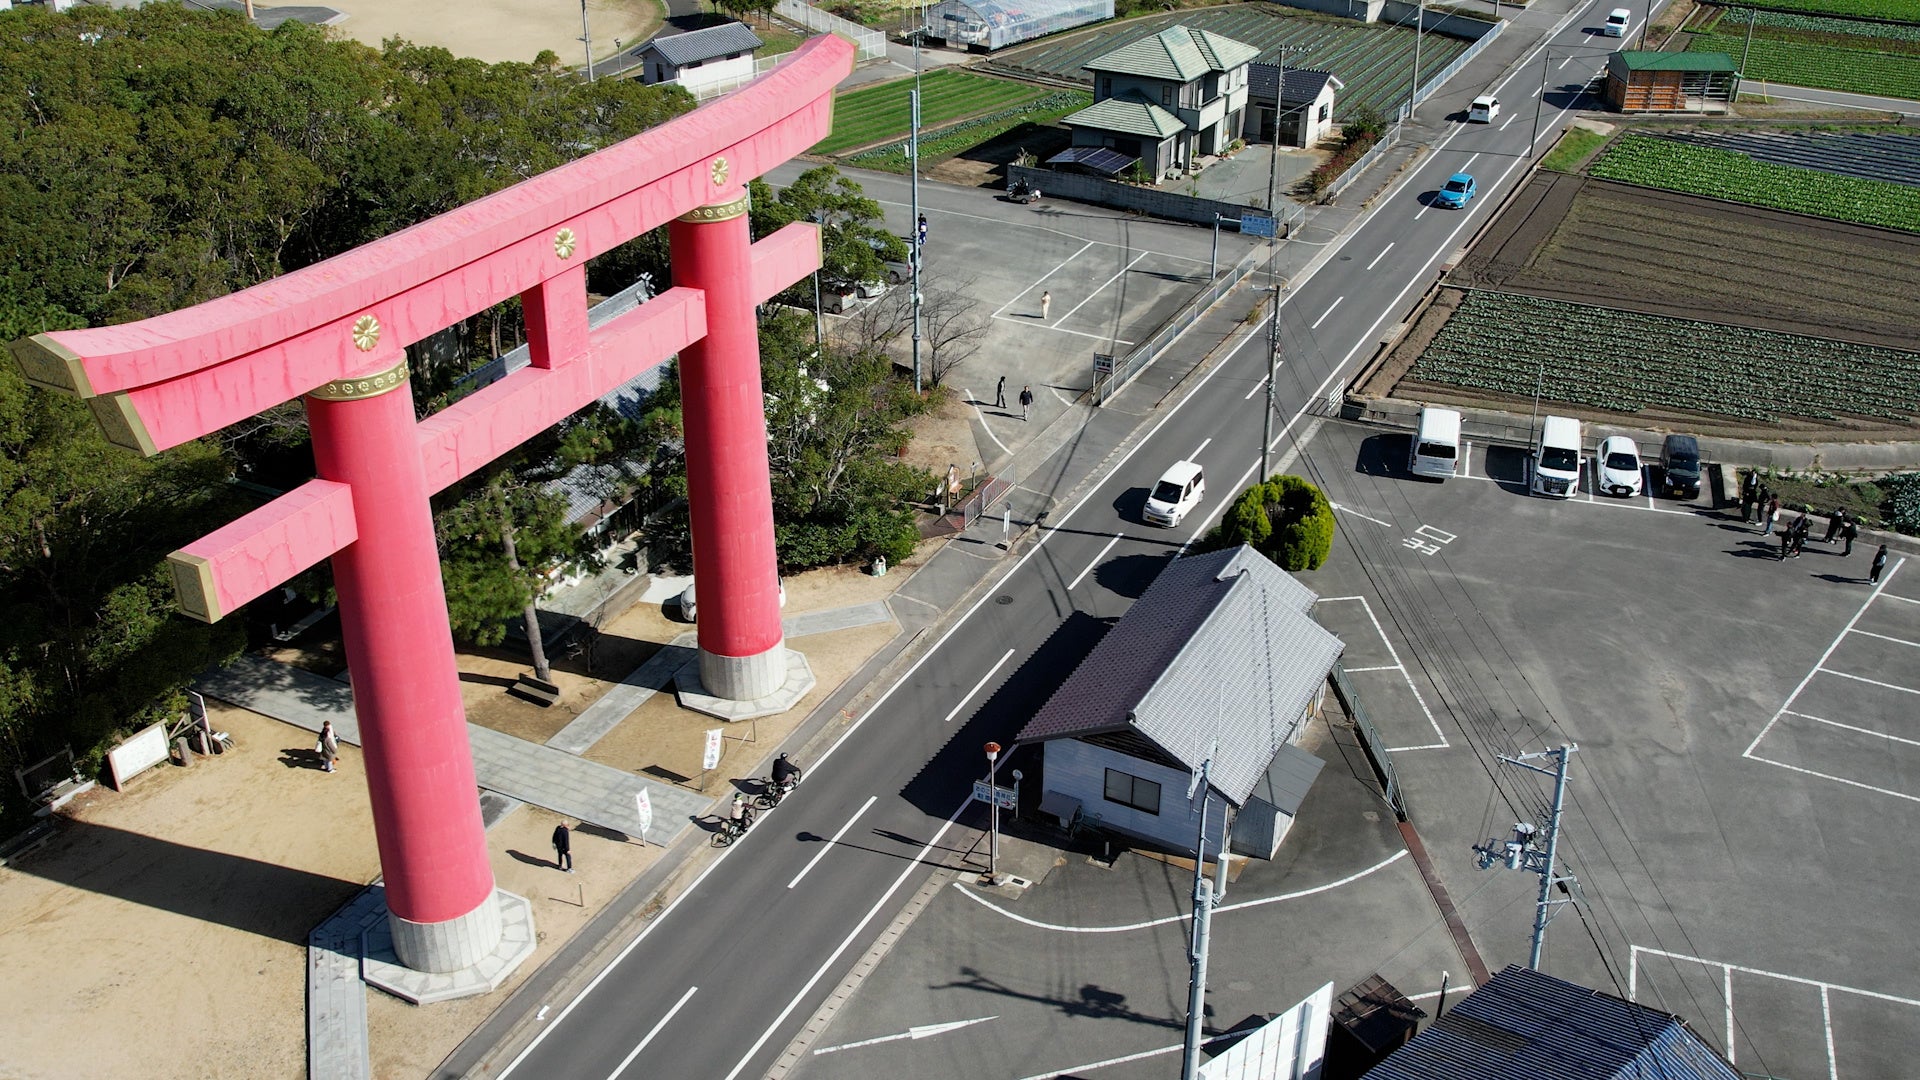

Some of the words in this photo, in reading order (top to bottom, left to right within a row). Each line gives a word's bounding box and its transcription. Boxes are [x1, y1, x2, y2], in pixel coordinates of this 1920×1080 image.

[1402, 524, 1458, 556] 出口
[975, 785, 1011, 801] おのこ島神社
